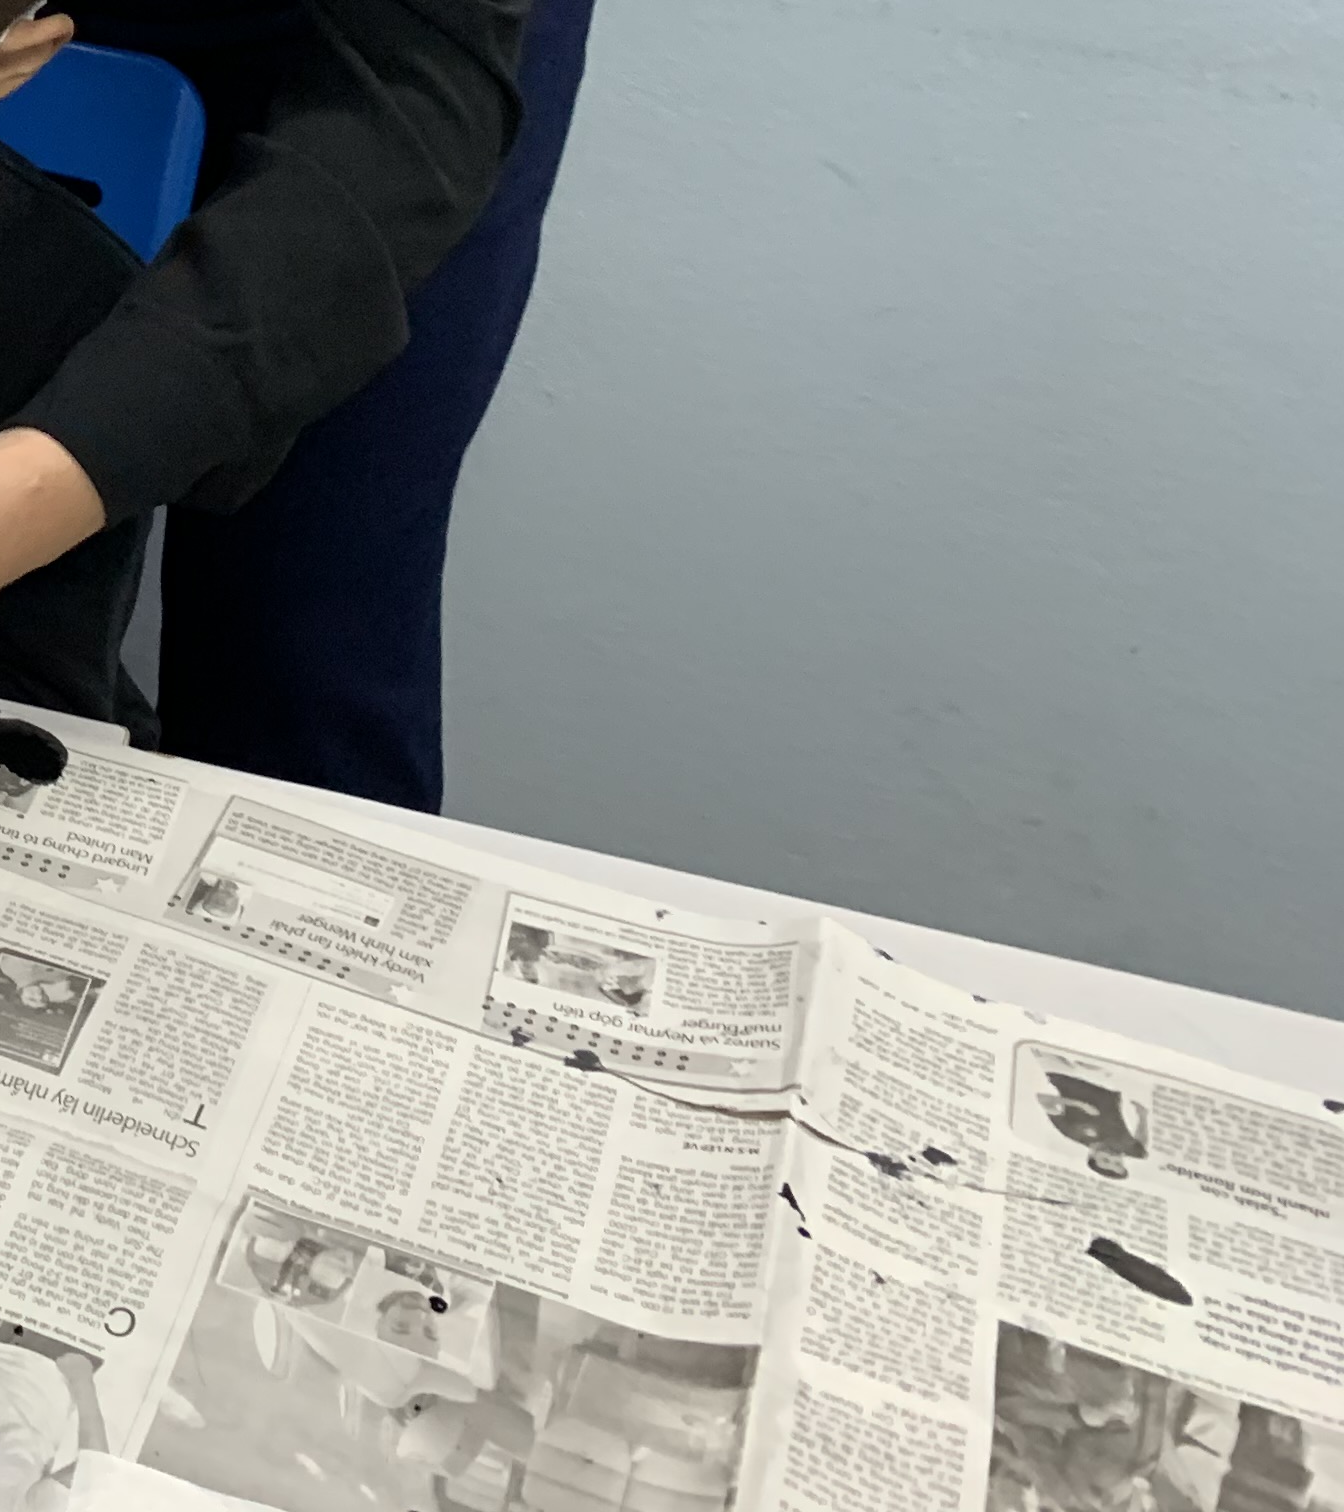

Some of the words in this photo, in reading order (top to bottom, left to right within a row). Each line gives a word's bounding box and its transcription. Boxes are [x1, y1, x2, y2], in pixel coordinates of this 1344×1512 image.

[65, 830, 116, 855] United
[118, 845, 153, 865] Man
[91, 851, 149, 876] Lingard
[292, 910, 359, 944] Wenger
[377, 957, 427, 983] Vardy
[627, 1019, 694, 1046] Neymar
[723, 1028, 780, 1056] Suarez
[78, 1099, 205, 1160] Schneiderlin
